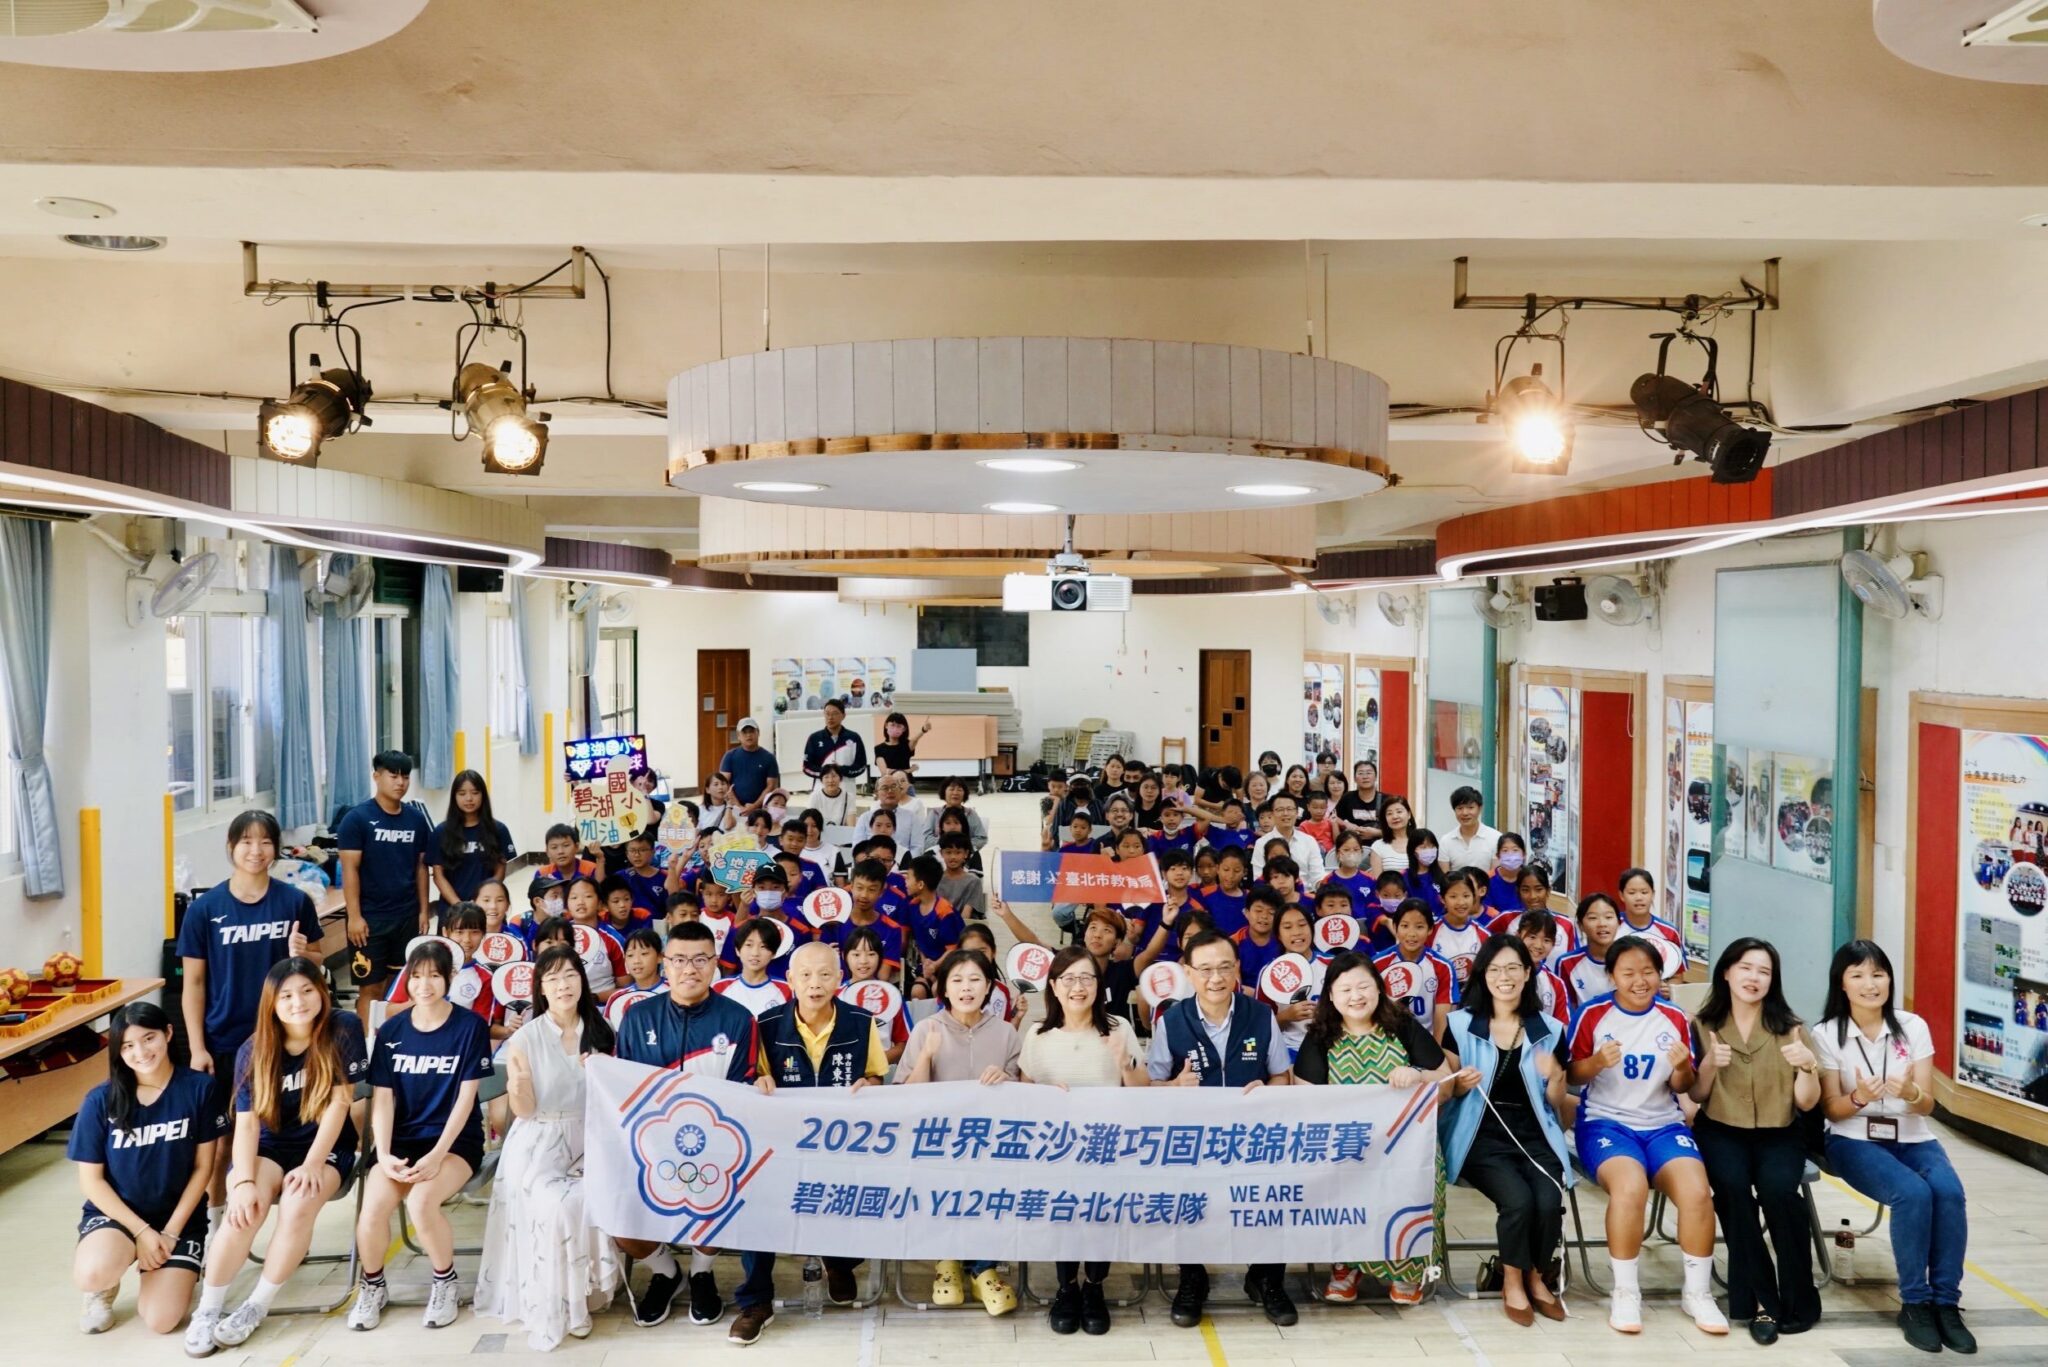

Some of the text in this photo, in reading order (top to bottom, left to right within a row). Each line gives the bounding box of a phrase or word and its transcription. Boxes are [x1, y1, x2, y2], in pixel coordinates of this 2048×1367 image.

[374, 828, 415, 843] TAIPEI
[580, 819, 620, 843] 加油
[1011, 869, 1155, 889] 感謝 臺北市教育局
[819, 891, 837, 918] 必勝
[220, 920, 290, 945] TAIPEI
[1327, 919, 1345, 945] 必勝
[489, 936, 509, 961] 必勝
[1023, 949, 1043, 979] 必勝
[1272, 961, 1300, 992] 必勝
[511, 966, 533, 996] 必勝
[1388, 968, 1408, 997] 必勝
[392, 1054, 460, 1075] TAIPEI
[1624, 1054, 1656, 1080] 87
[111, 1117, 191, 1149] TAIPEI
[796, 1116, 1373, 1166] 2025 世界盃沙灘巧固球錦標賽
[790, 1181, 1208, 1226] 碧湖國小 Y12中華台北代表隊
[1230, 1184, 1304, 1203] WE ARE
[1230, 1207, 1367, 1227] TEAM TAIWAN
[186, 1240, 201, 1256] 12
